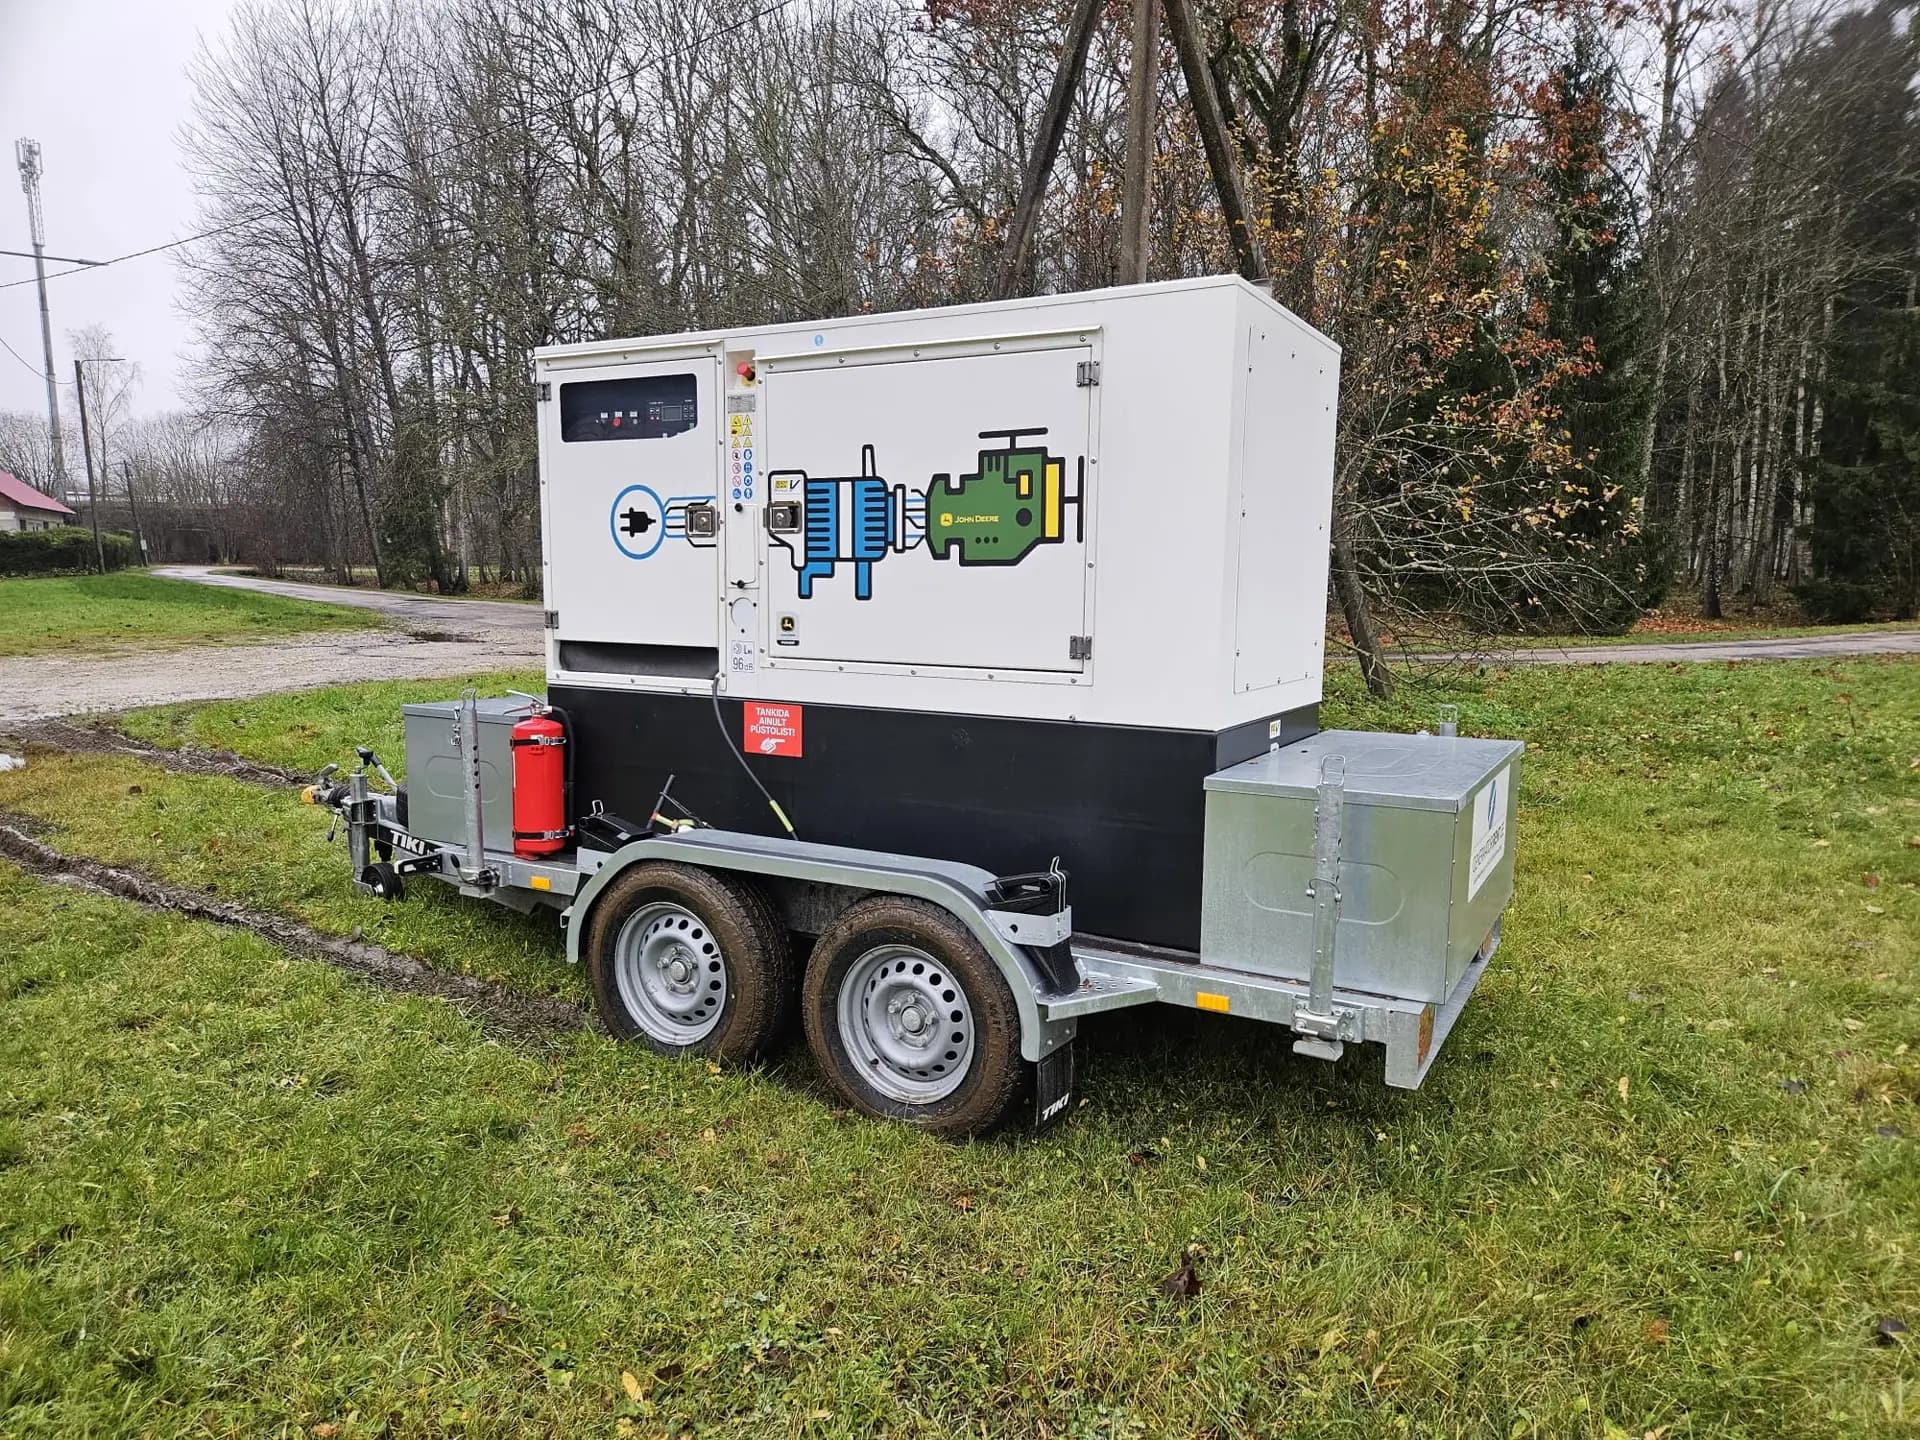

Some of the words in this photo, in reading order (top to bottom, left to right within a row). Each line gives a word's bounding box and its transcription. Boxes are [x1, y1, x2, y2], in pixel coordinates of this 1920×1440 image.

[954, 516, 974, 524] JOHN
[975, 515, 1000, 523] DEERE
[733, 657, 743, 670] 96
[755, 707, 790, 718] TANKIDA
[759, 716, 787, 727] AINULT
[390, 829, 425, 855] TIKI
[1042, 1092, 1070, 1121] TIKI
